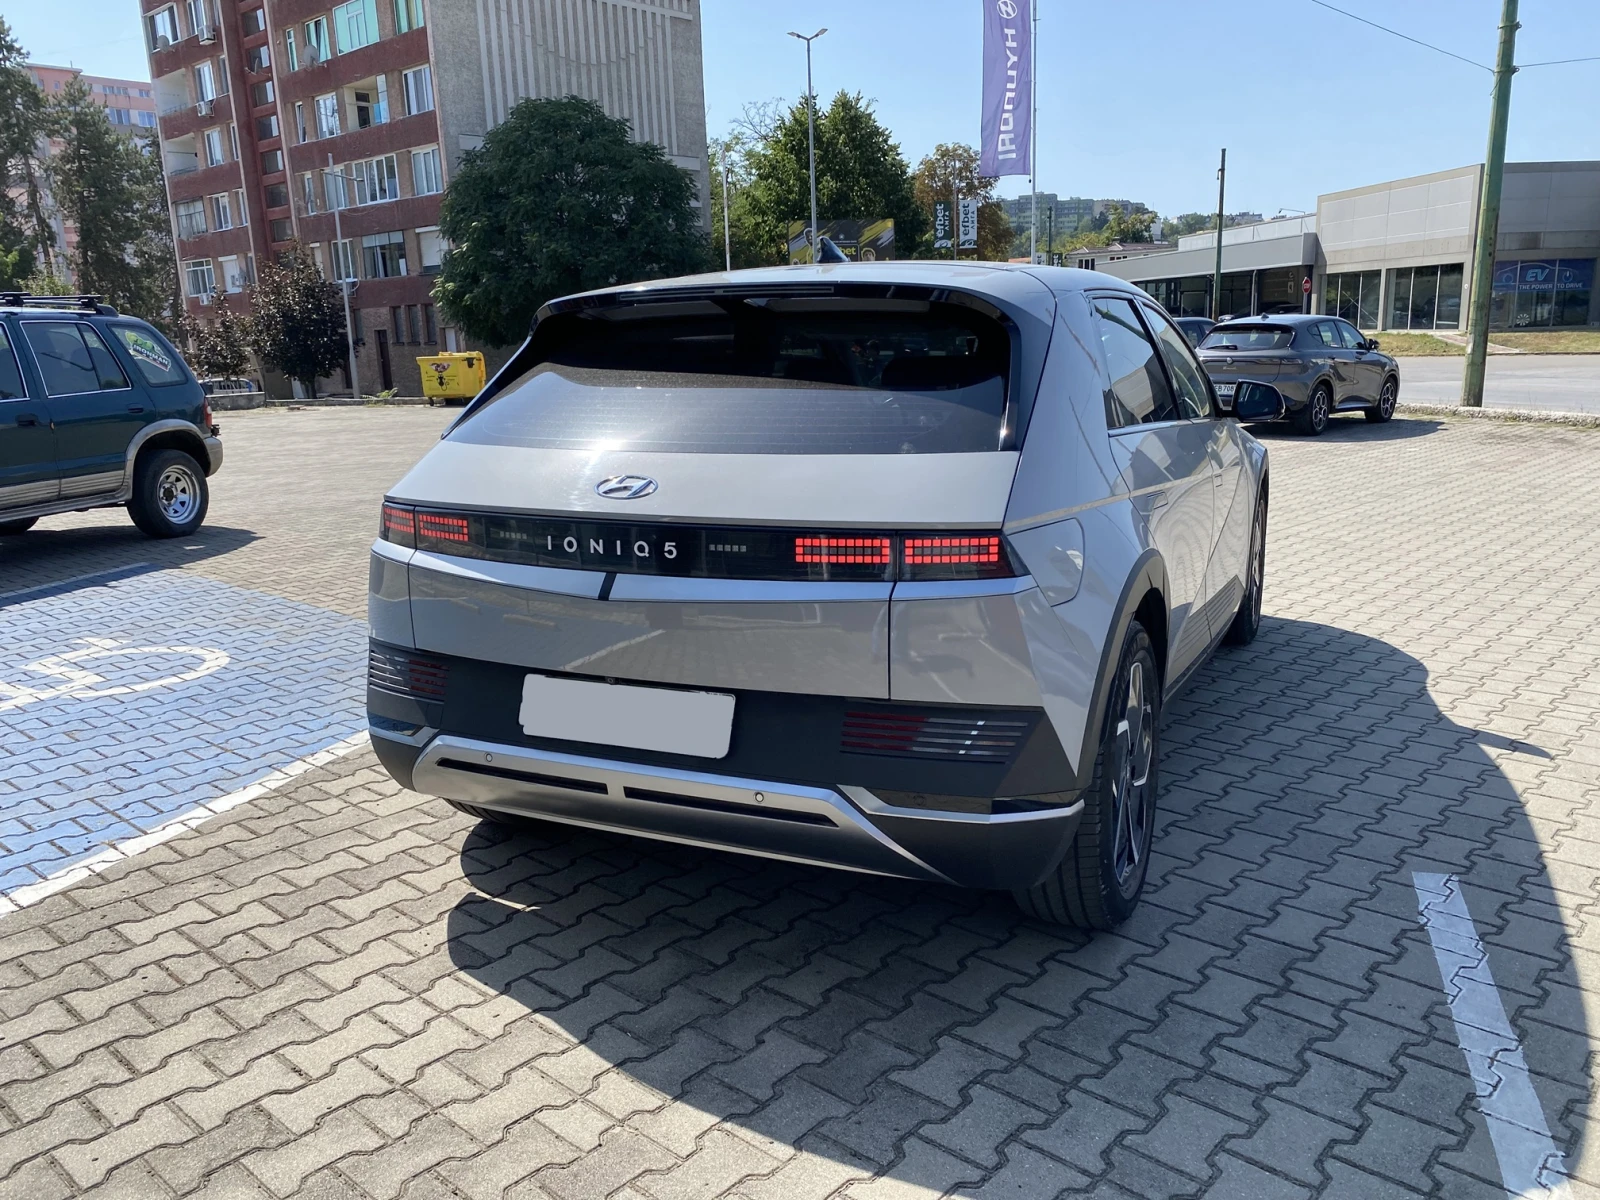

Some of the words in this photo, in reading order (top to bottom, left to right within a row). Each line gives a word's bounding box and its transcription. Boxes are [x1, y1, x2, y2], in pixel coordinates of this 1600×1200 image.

[935, 203, 944, 238] efbet
[961, 203, 970, 236] efbet
[840, 246, 856, 255] bet
[1525, 268, 1550, 282] EV
[547, 535, 650, 557] IONIQ
[663, 541, 677, 559] 5
